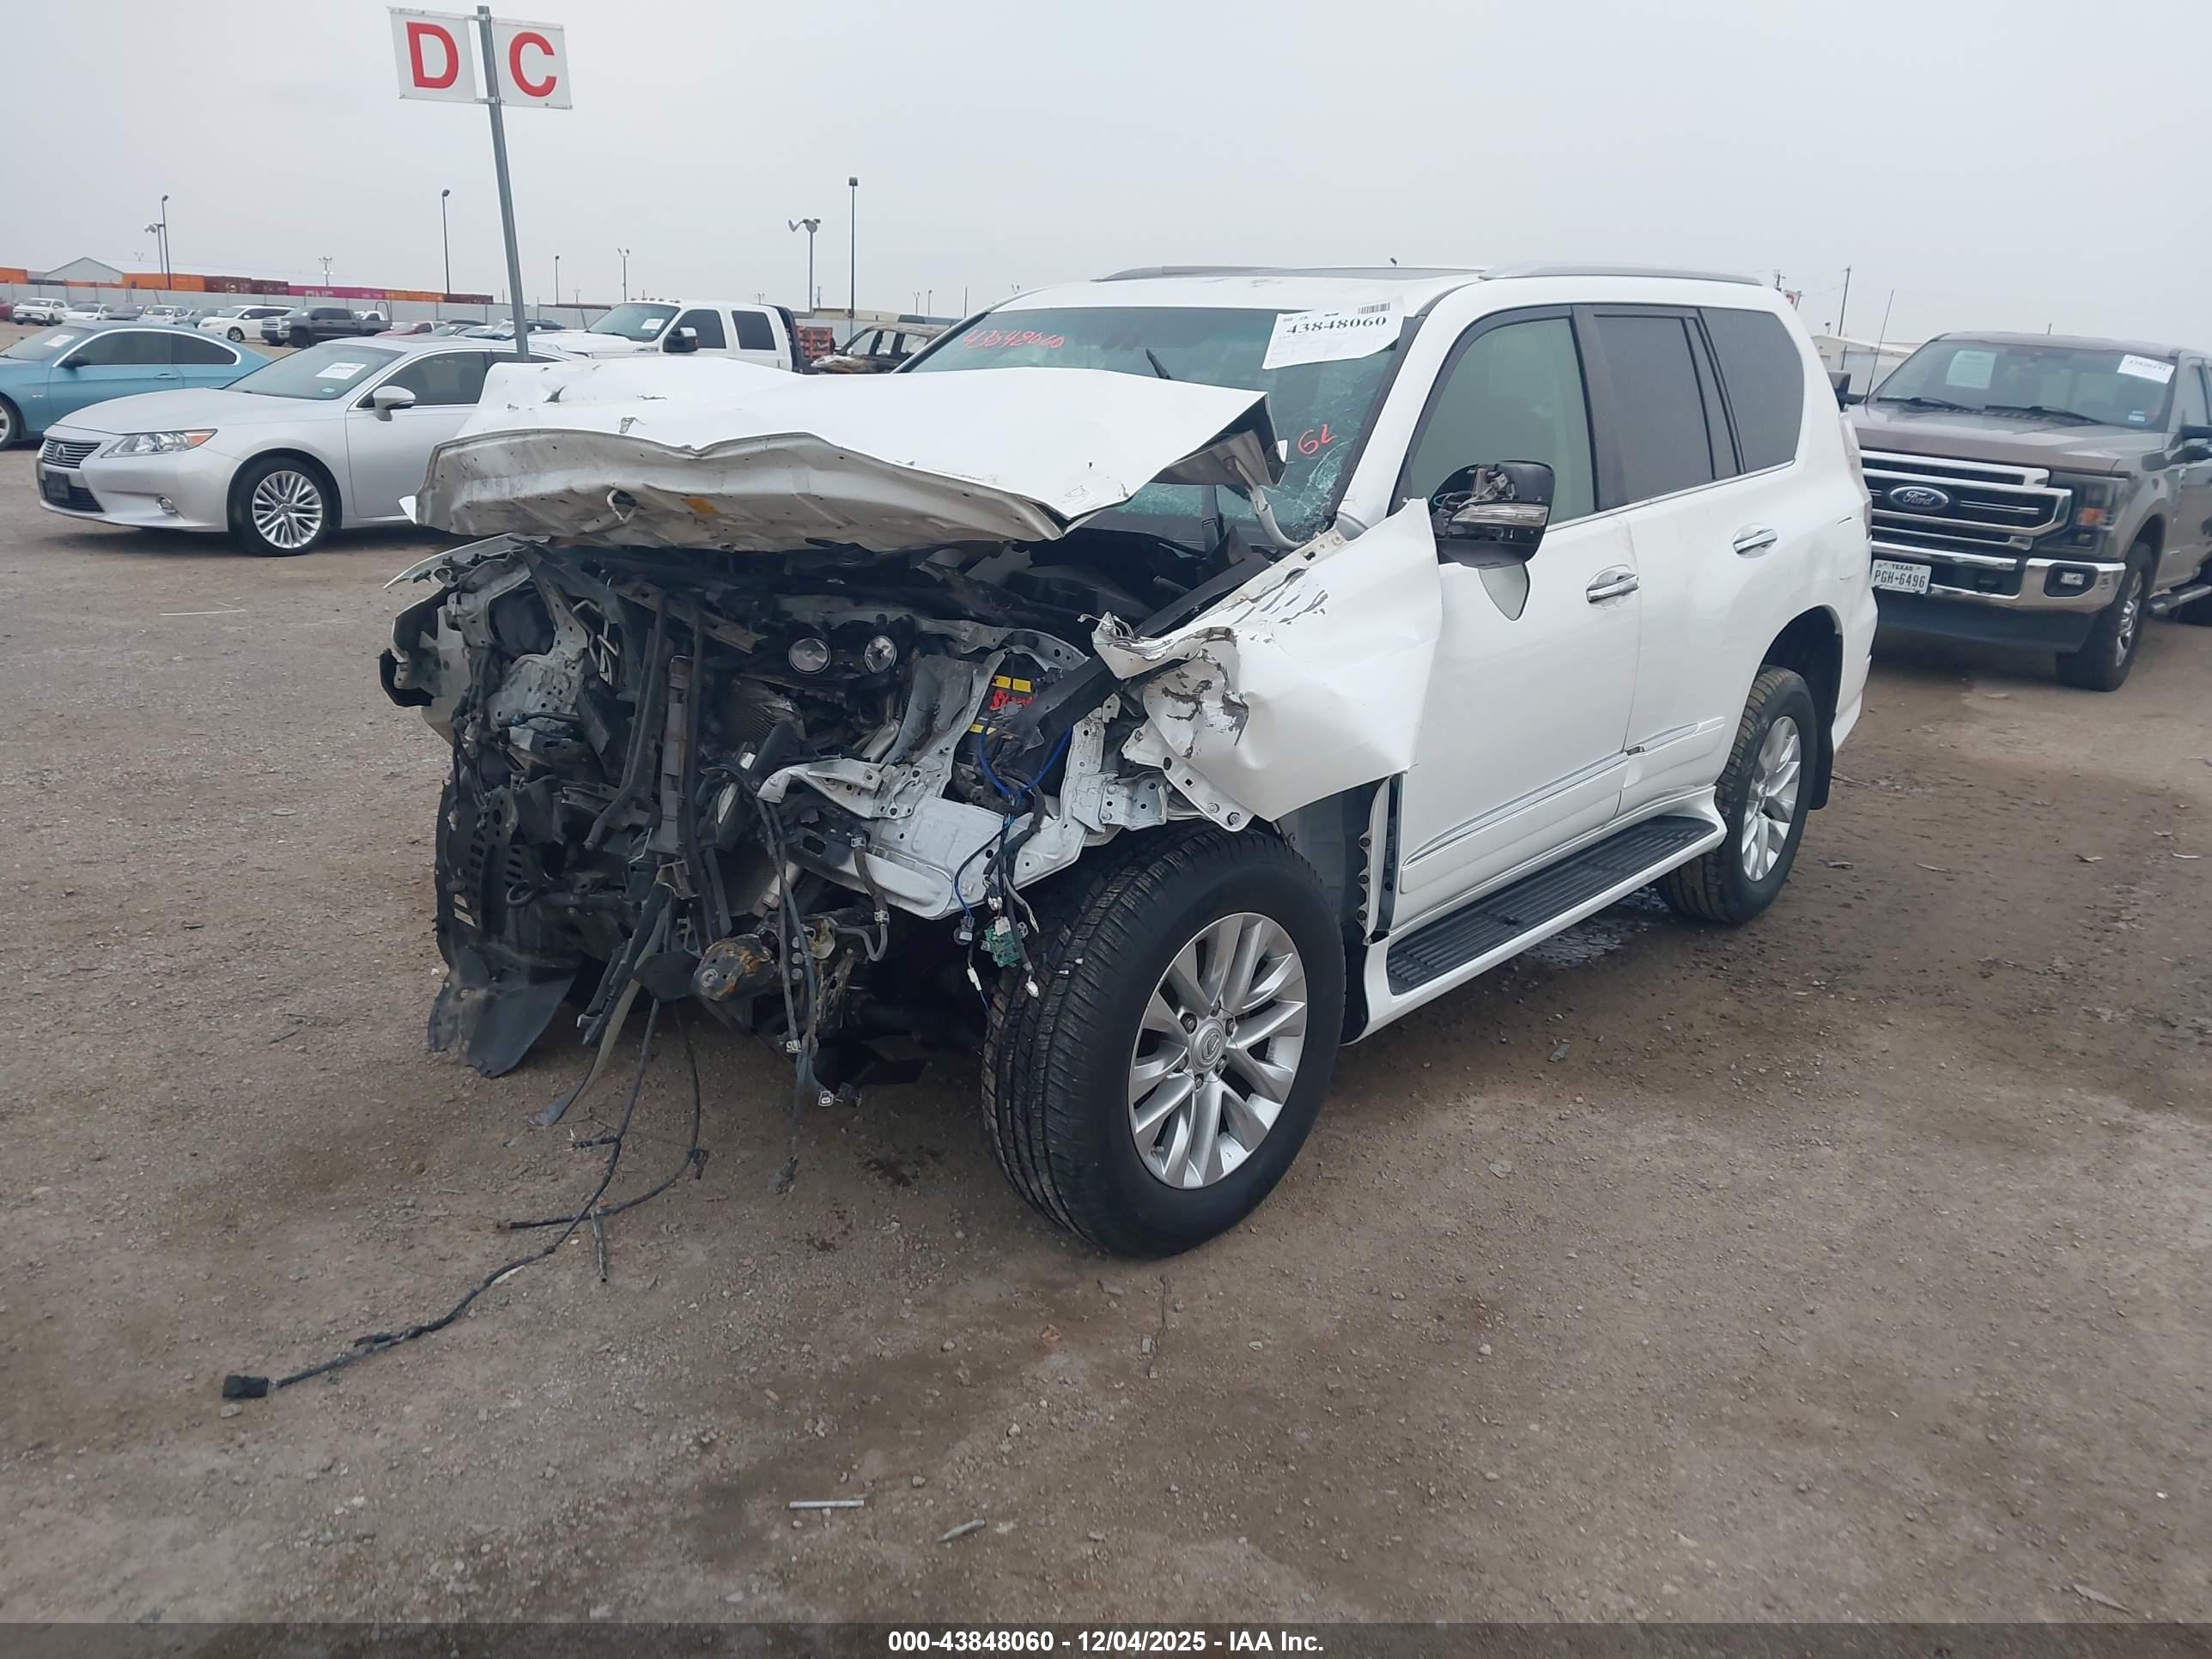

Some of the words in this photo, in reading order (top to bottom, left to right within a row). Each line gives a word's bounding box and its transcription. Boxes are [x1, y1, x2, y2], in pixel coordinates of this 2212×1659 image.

[406, 21, 459, 89] D
[509, 32, 557, 97] C
[1286, 315, 1388, 335] 43848060
[1902, 490, 1936, 506] Ford
